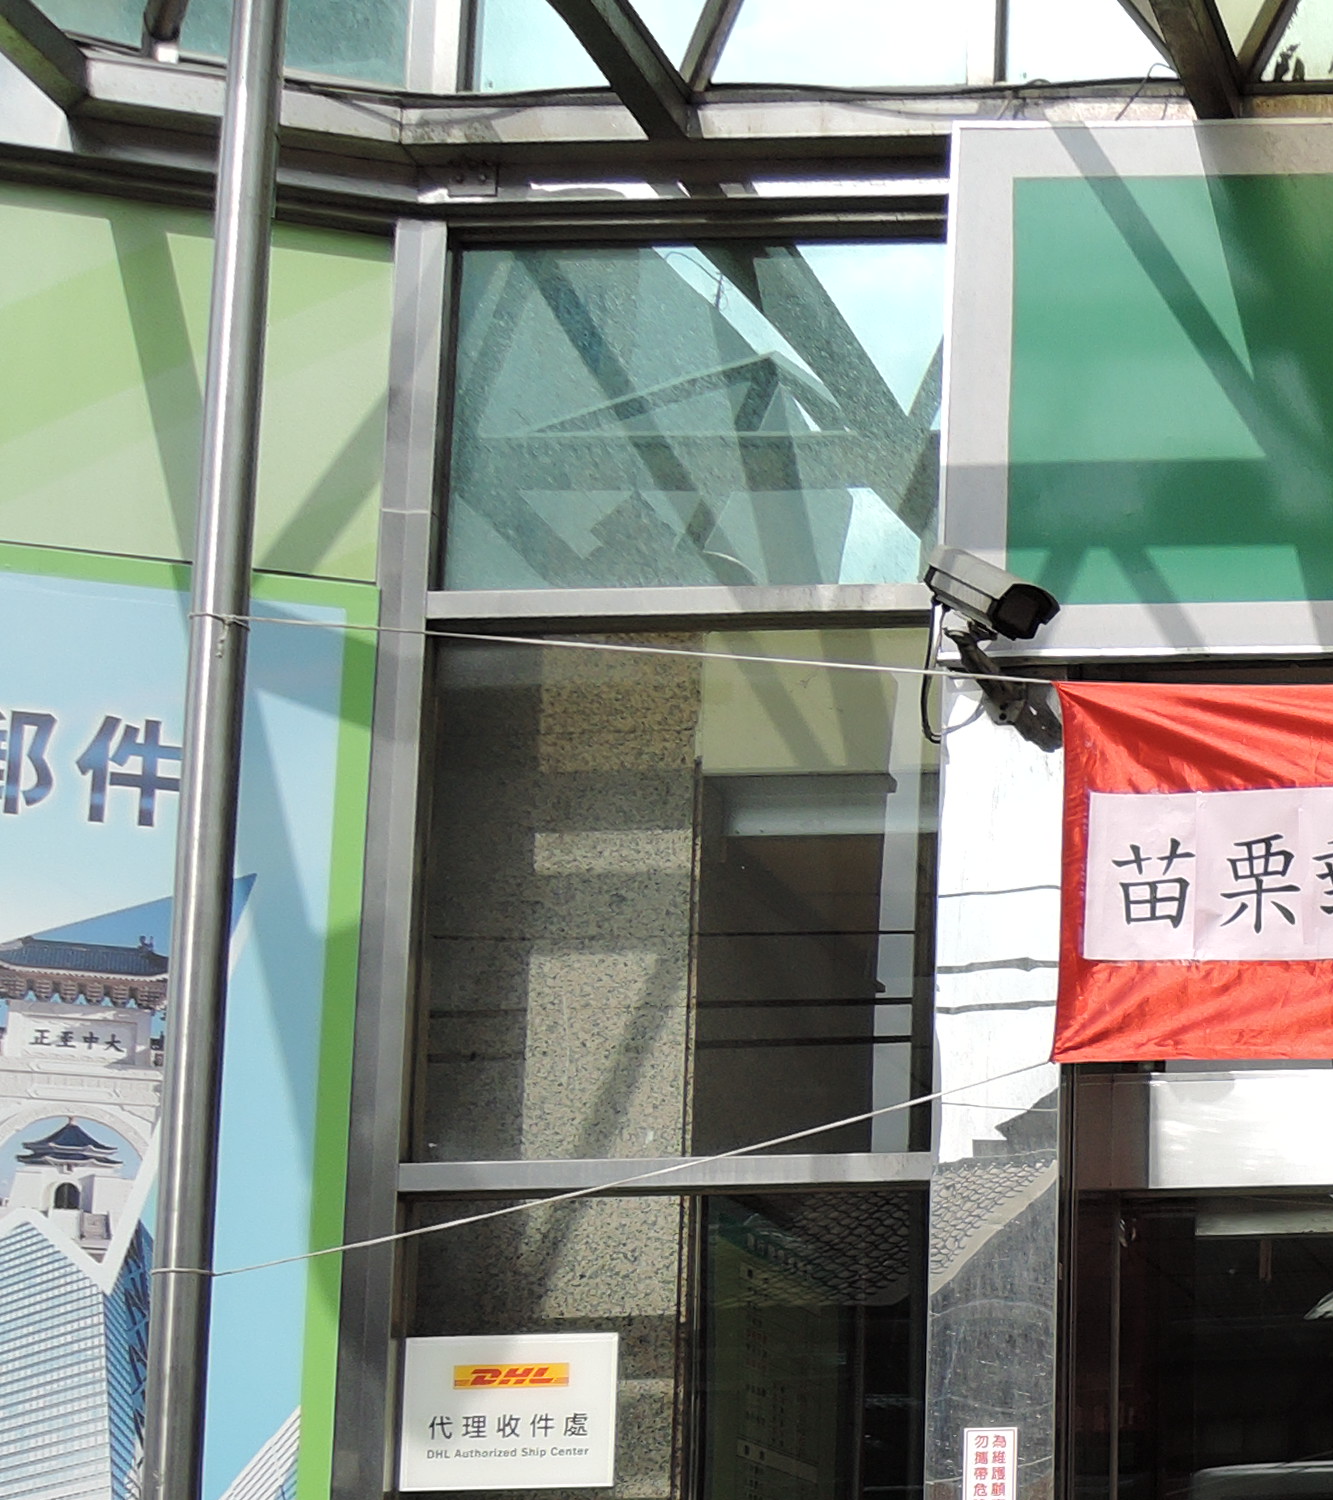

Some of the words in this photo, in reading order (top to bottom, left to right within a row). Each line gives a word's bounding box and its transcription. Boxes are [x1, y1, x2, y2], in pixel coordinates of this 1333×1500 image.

[470, 1366, 555, 1386] DHL
[428, 1412, 589, 1440] 代理收件處
[426, 1449, 451, 1460] DHL
[453, 1448, 518, 1459] Authorized
[520, 1447, 547, 1459] Ship
[550, 1446, 589, 1457] Center
